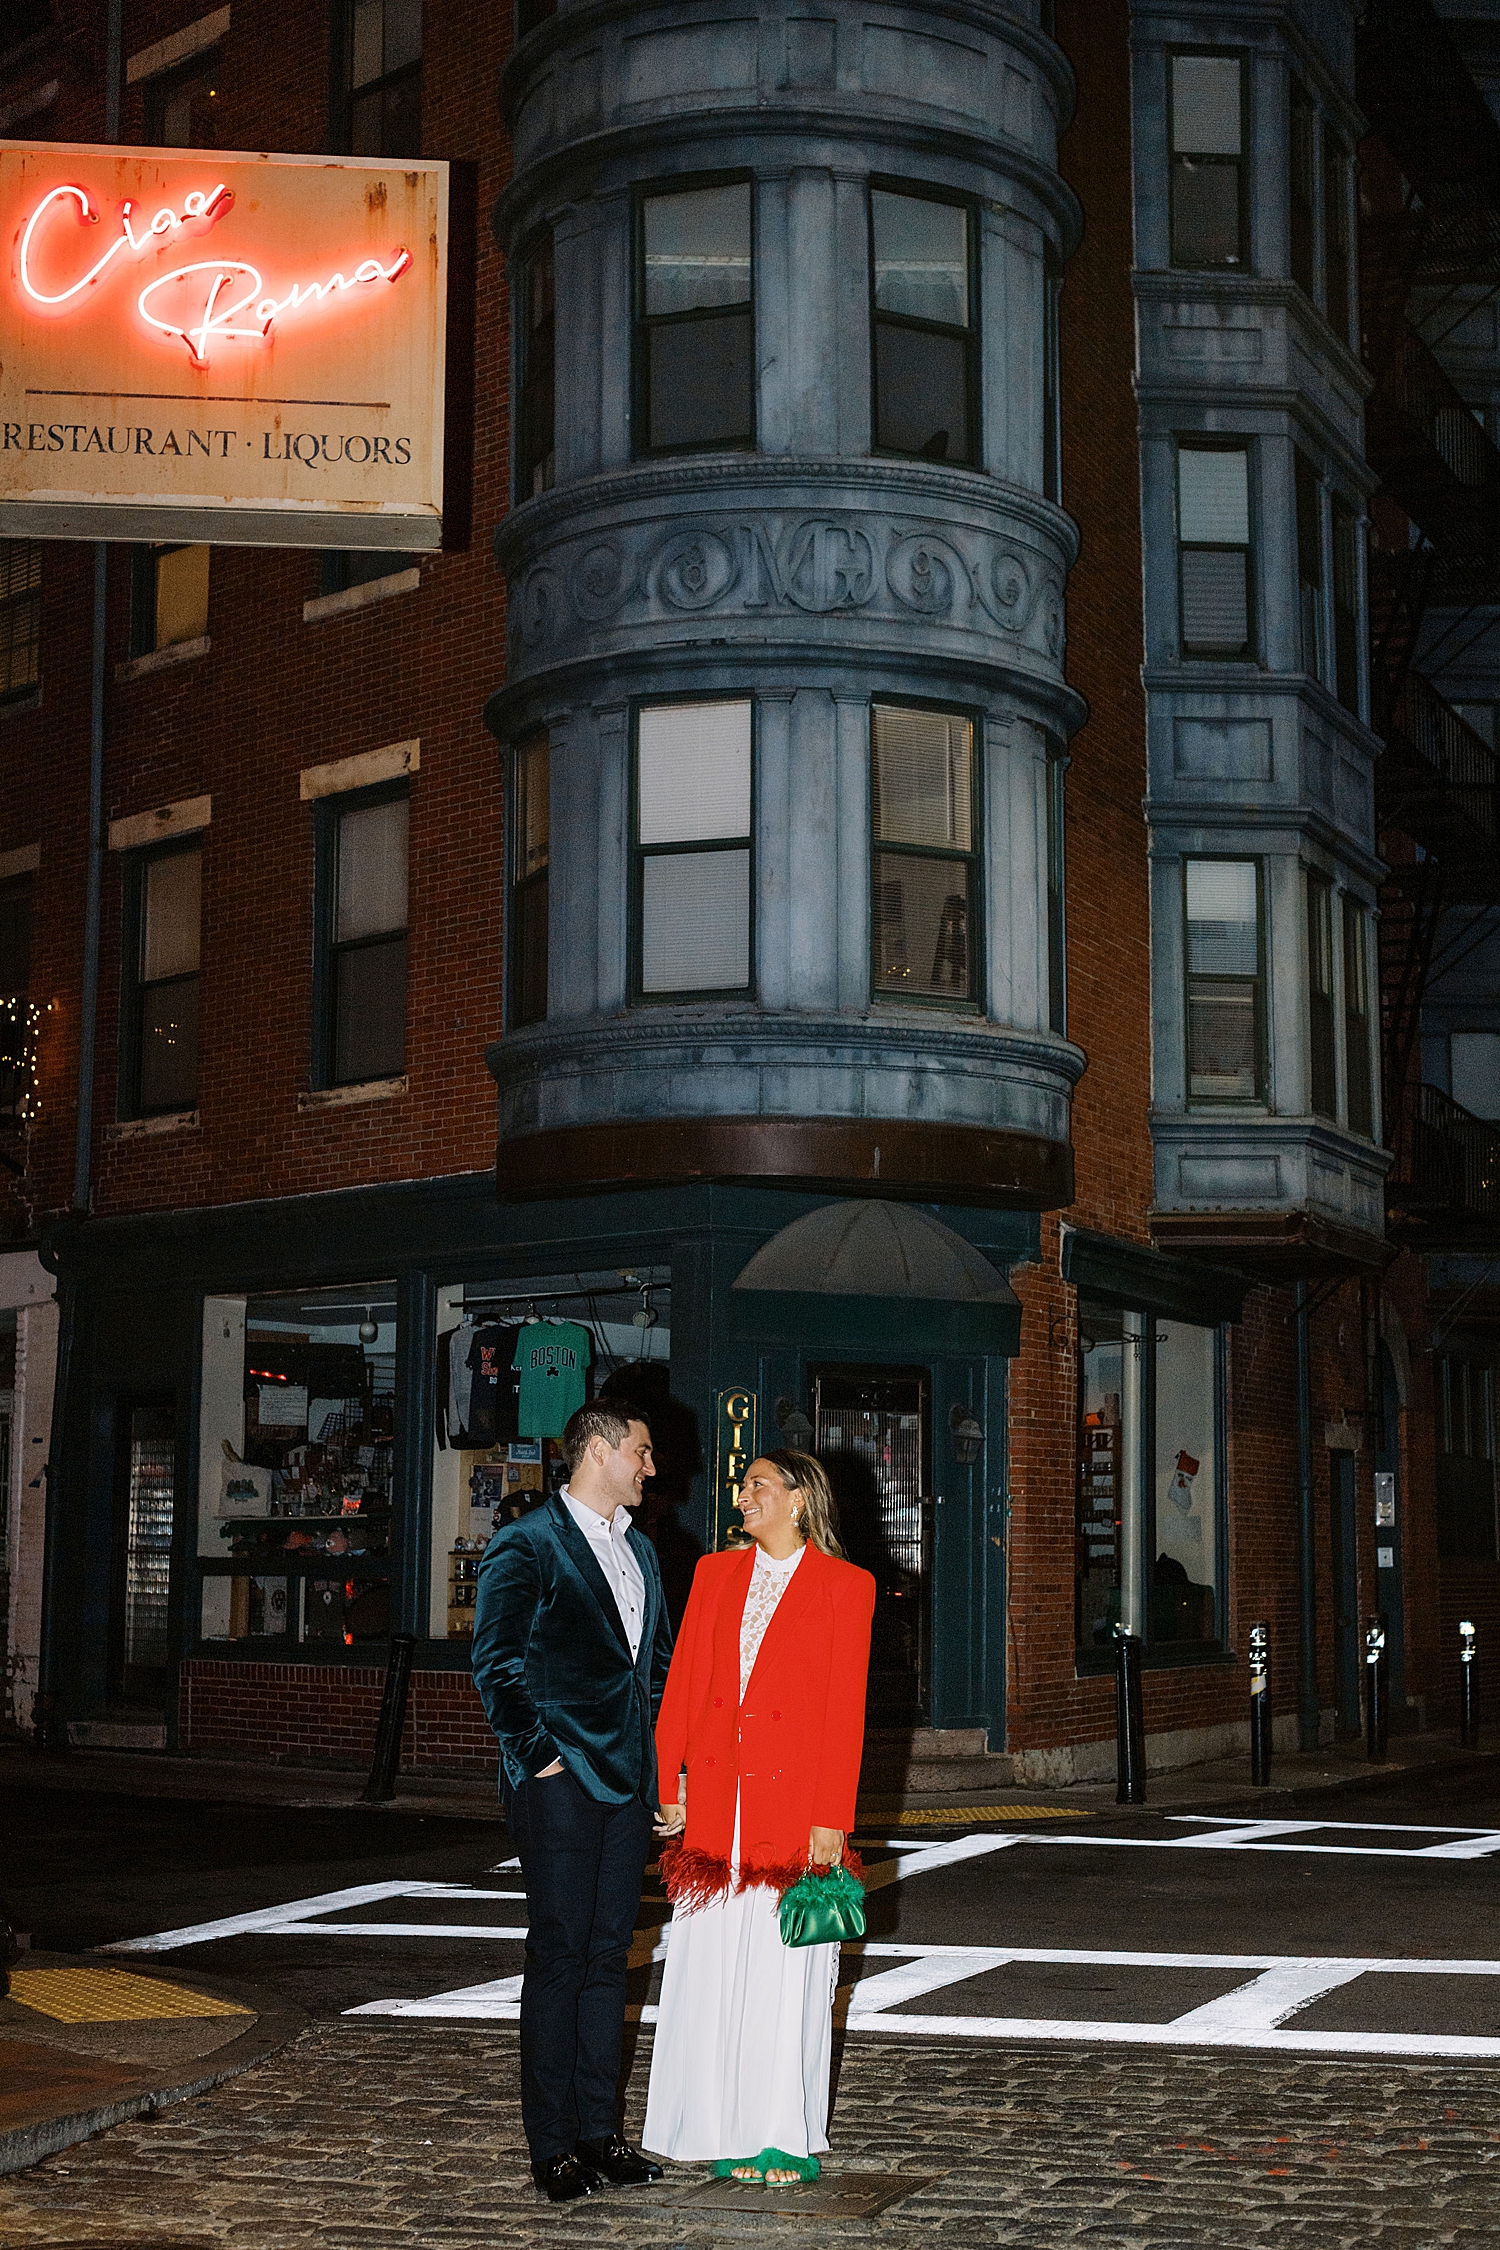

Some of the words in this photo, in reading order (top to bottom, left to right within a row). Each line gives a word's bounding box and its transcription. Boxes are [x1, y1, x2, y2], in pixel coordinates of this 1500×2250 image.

[20, 184, 229, 304] Ciao
[138, 252, 410, 360] Roma
[2, 422, 237, 458] RESTAURANT
[263, 431, 412, 469] LIQUORS
[529, 1346, 576, 1370] BOSTON
